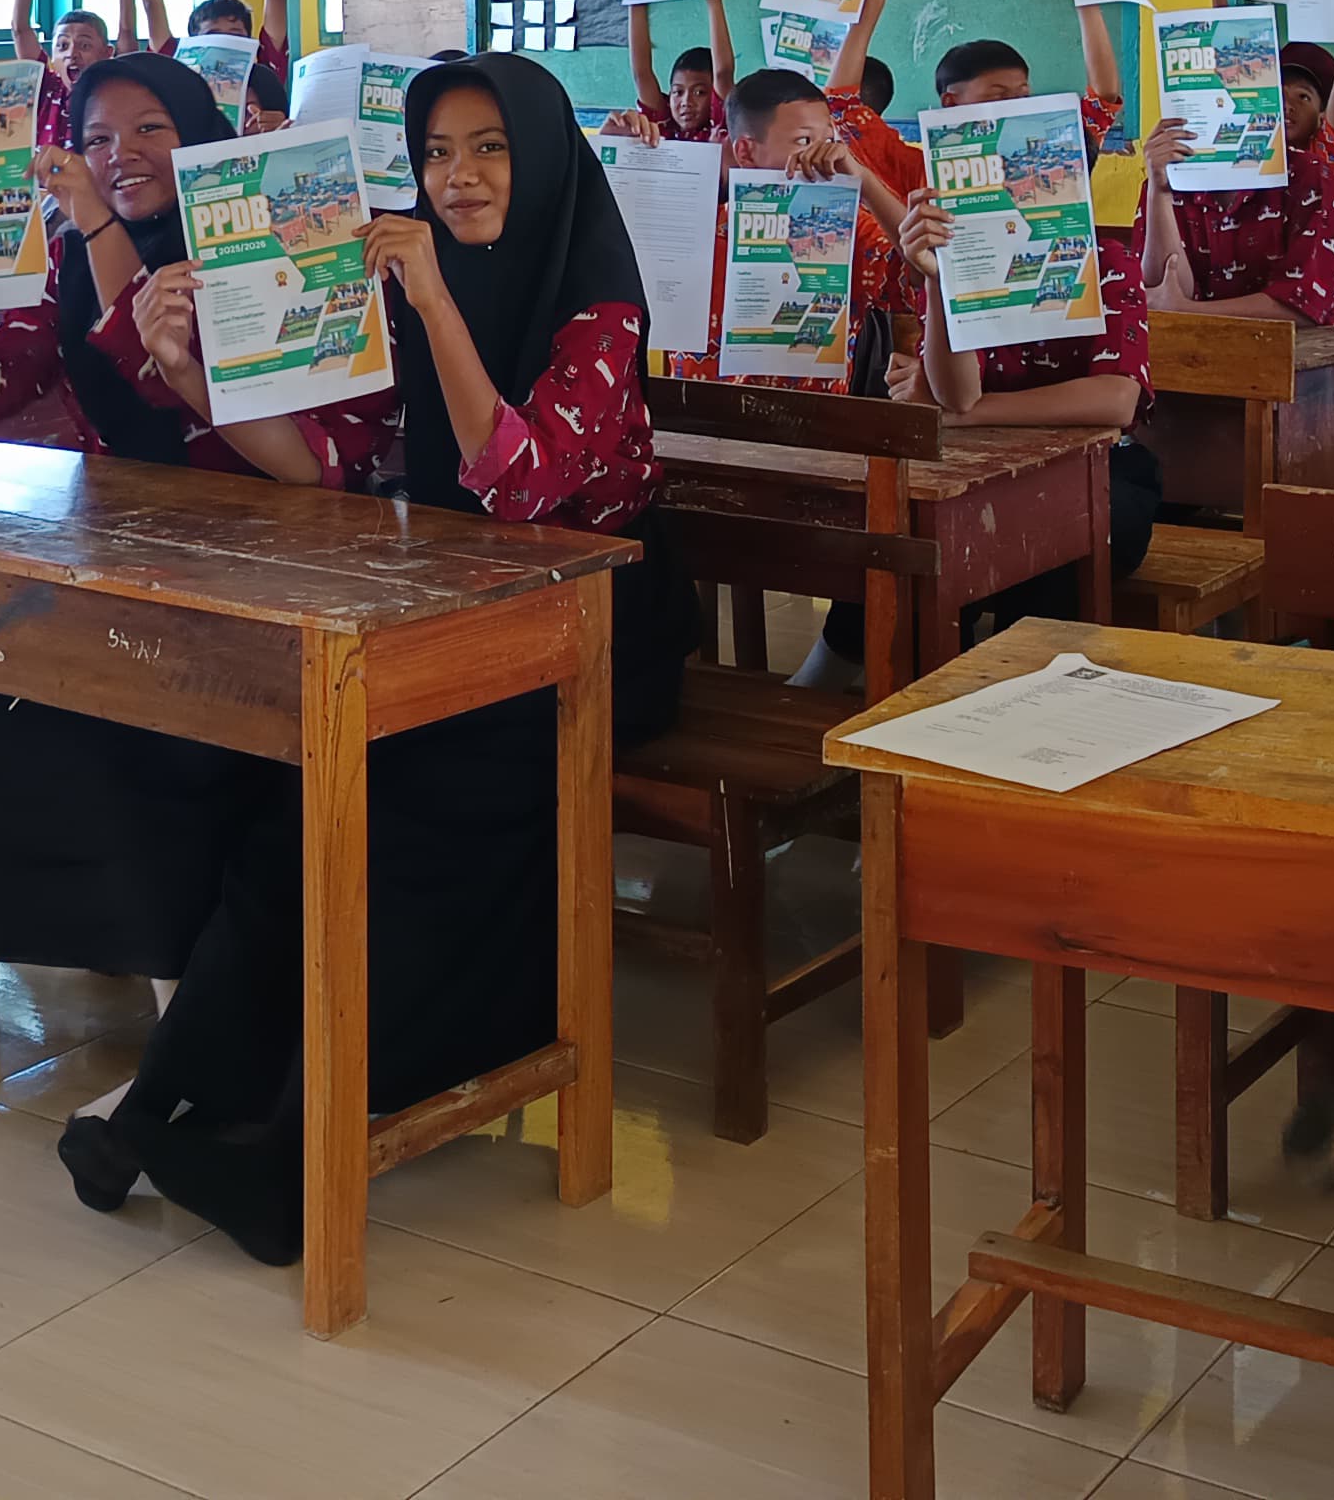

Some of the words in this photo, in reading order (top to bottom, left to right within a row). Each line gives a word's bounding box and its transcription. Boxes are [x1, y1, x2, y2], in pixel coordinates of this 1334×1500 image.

[1166, 47, 1216, 73] PPDB
[363, 85, 404, 107] PPDB
[937, 155, 1005, 191] PPDB
[192, 194, 272, 241] PPDB
[738, 214, 790, 240] PPDB
[218, 241, 267, 256] 2025/2026
